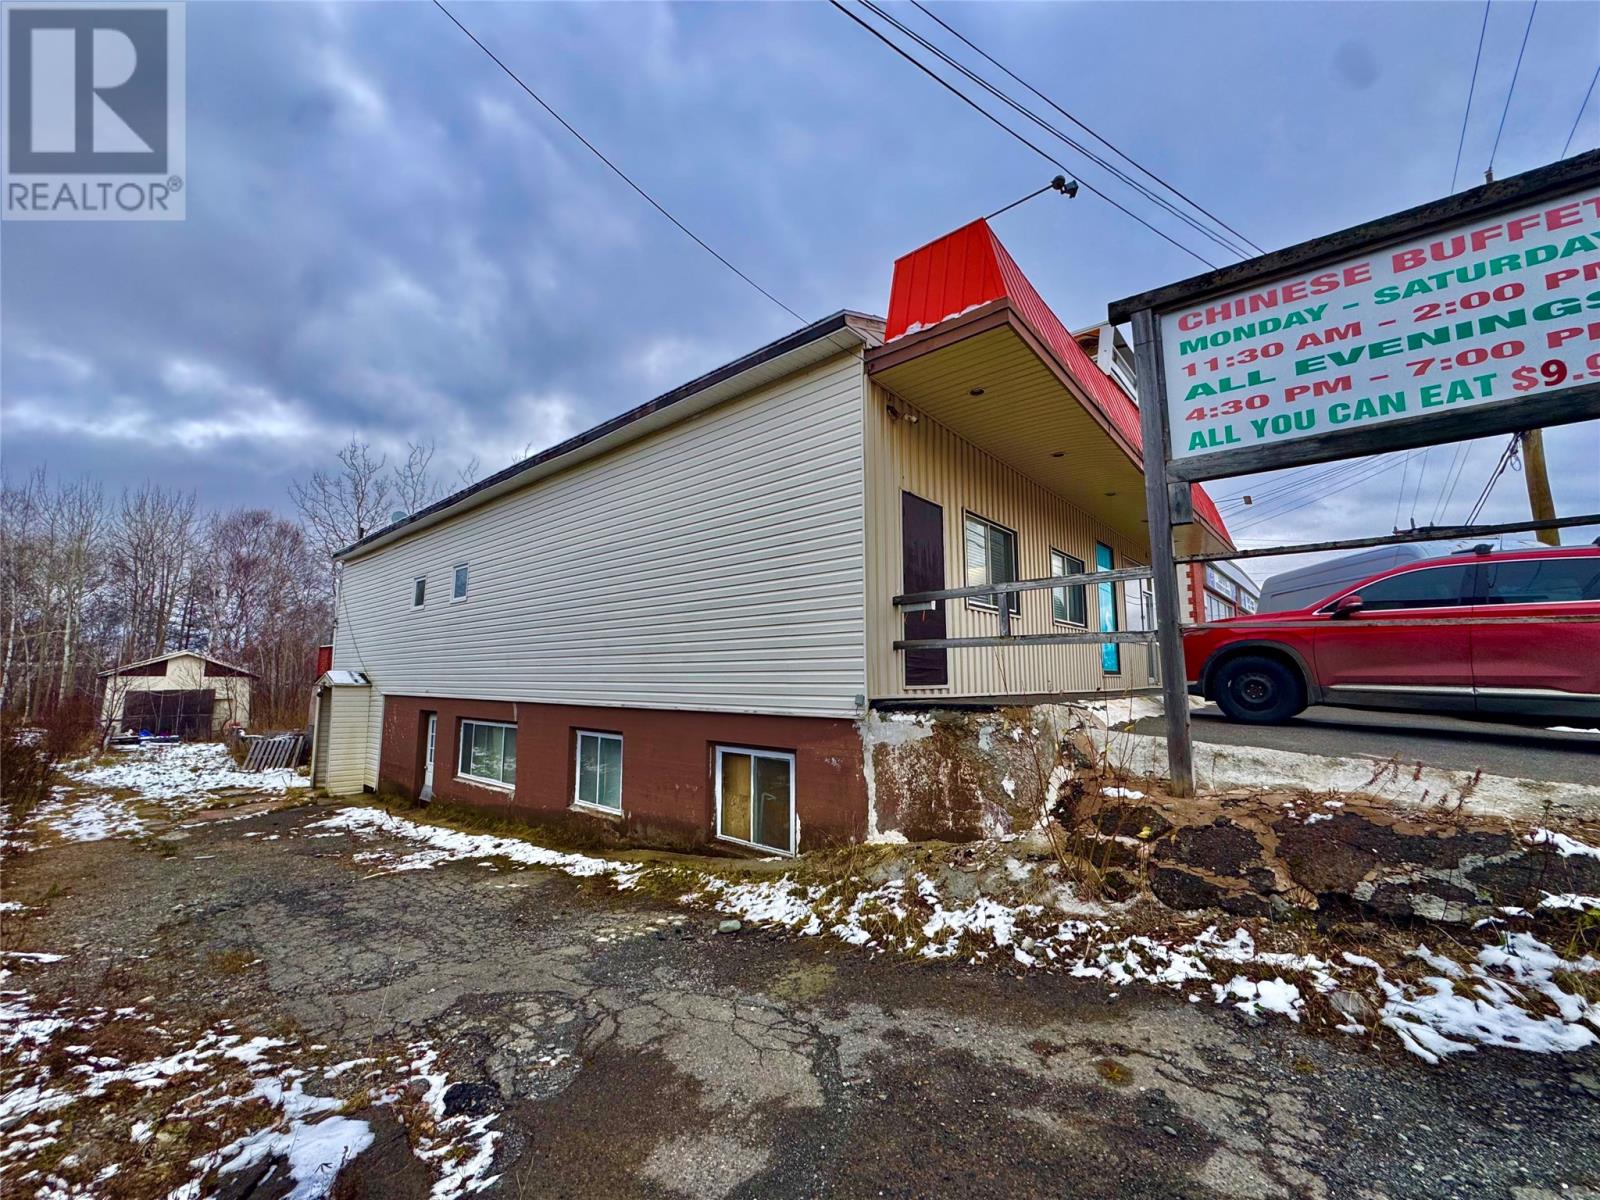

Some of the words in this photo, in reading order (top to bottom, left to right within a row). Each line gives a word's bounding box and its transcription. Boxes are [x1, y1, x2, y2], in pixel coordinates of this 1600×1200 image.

[1178, 262, 1372, 332] CHINESE
[1179, 303, 1328, 356] MONDAY
[1181, 342, 1284, 377] 11:30
[1296, 321, 1362, 351] AM
[1413, 282, 1525, 322] 2:00
[1184, 370, 1276, 401] ALL
[1185, 394, 1270, 421] 4:30
[1284, 375, 1352, 403] PM
[1406, 340, 1525, 377] 7:00
[1188, 424, 1241, 451] ALL
[1250, 408, 1316, 438] YOU
[1328, 391, 1406, 424] CAN
[1420, 373, 1497, 408] EAT
